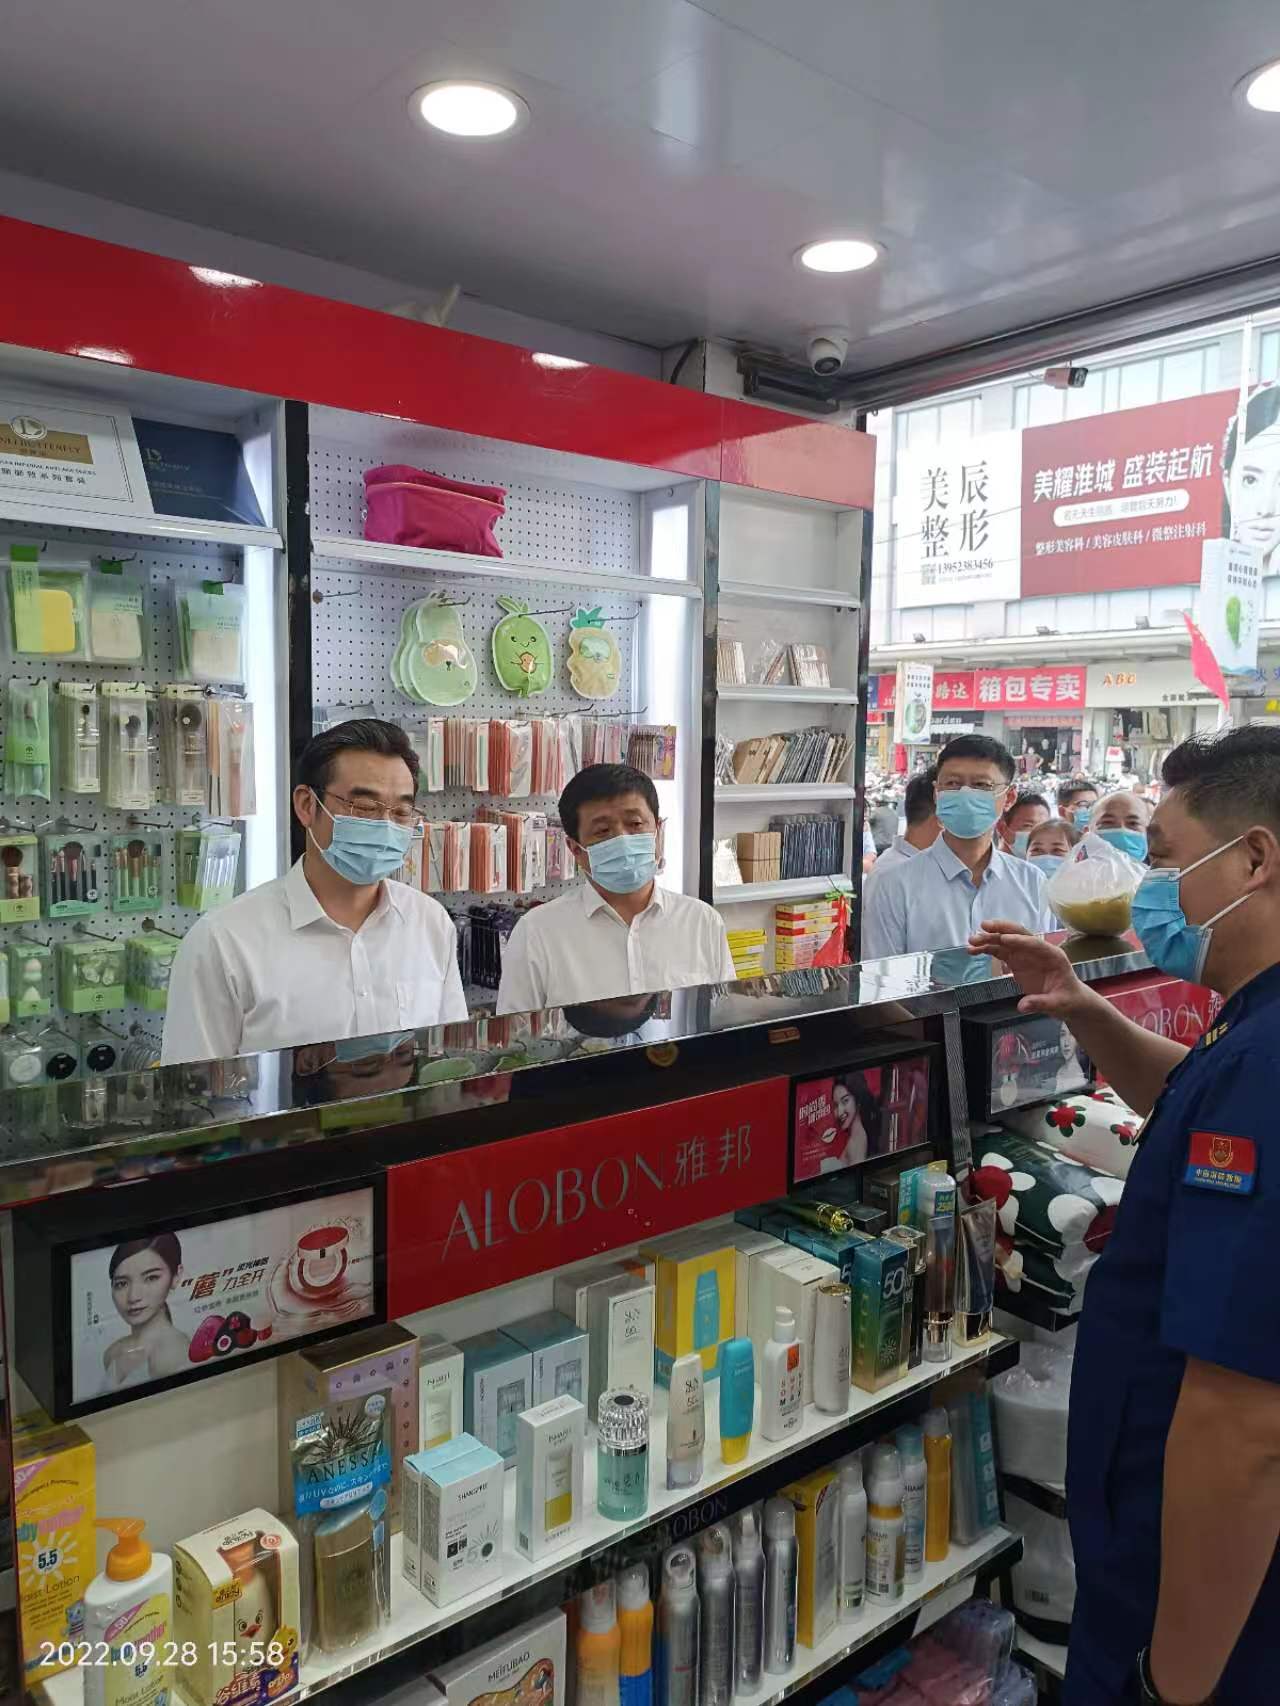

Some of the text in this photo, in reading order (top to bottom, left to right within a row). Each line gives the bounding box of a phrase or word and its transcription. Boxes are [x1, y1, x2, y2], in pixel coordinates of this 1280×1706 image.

[1033, 443, 1214, 503] 美耀淮城 盛装起航
[979, 675, 1081, 702] 箱包专卖
[441, 1125, 750, 1262] ALOBON 雅邦
[881, 1267, 905, 1298] 50
[38, 1549, 58, 1569] 5.5
